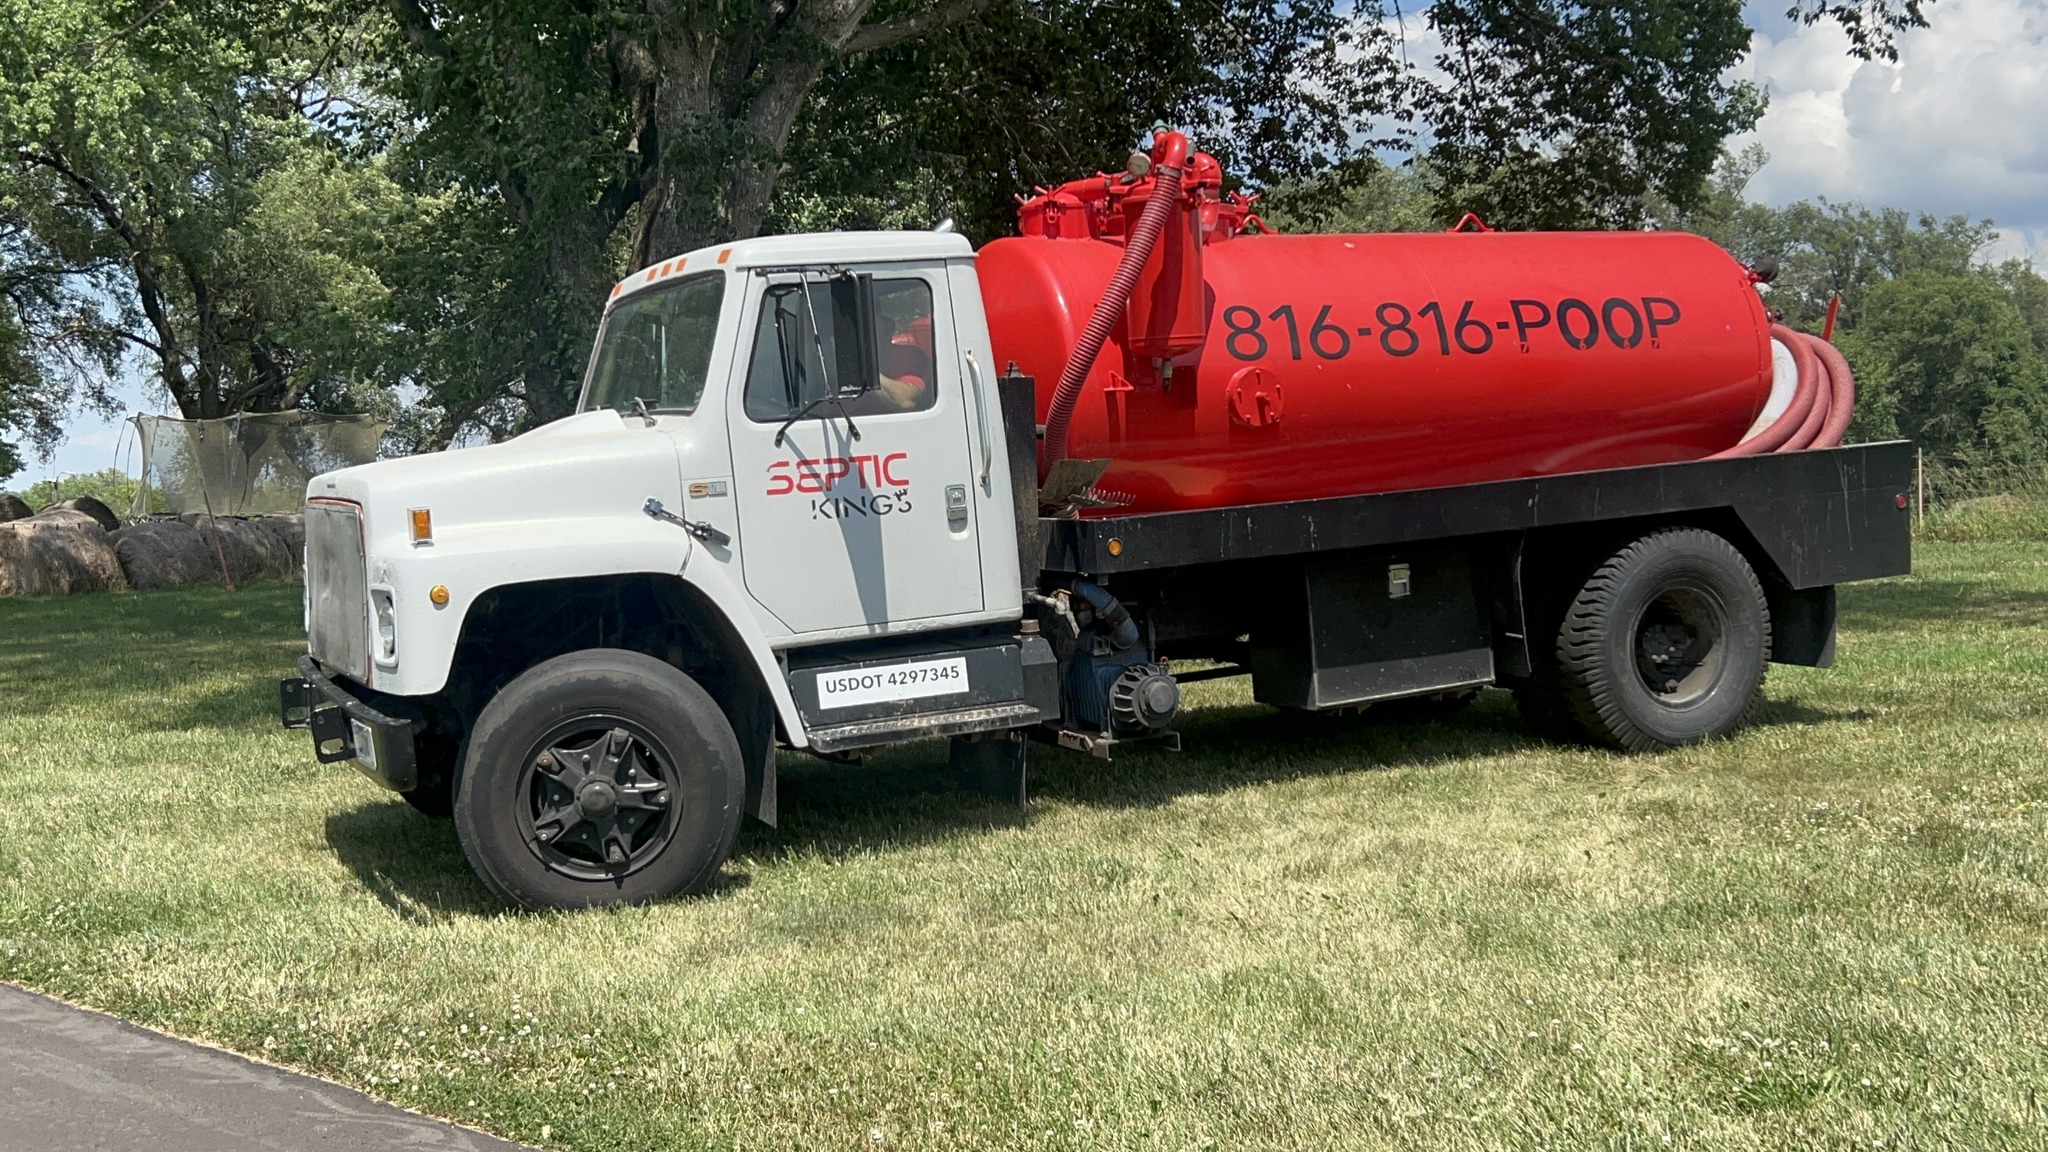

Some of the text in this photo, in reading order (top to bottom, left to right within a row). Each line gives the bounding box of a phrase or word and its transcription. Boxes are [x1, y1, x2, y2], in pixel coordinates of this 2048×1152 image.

[1223, 297, 1681, 361] 816-816-POOP
[766, 452, 910, 496] SEPTIC
[811, 489, 912, 520] KINGS
[825, 665, 960, 694] USDOT 4297345
